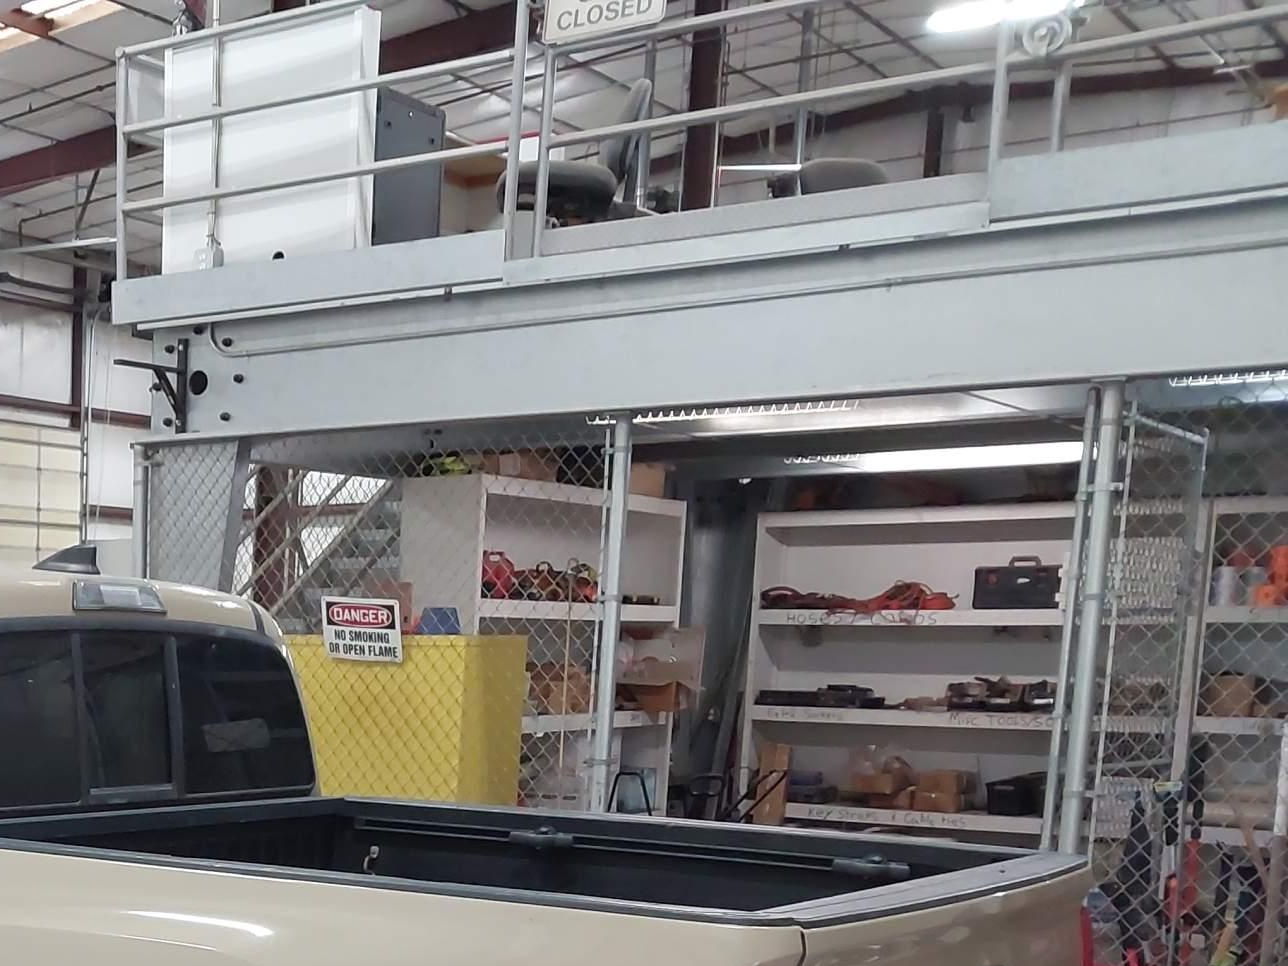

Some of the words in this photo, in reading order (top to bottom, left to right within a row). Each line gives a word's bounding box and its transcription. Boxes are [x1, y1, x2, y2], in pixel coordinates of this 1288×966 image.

[557, 0, 652, 30] CLOSED
[333, 607, 388, 624] DANGER
[334, 629, 346, 641] NO
[348, 630, 390, 644] SMOKING
[329, 642, 340, 654] OR
[343, 643, 365, 656] OPEN
[368, 645, 398, 658] FLAME
